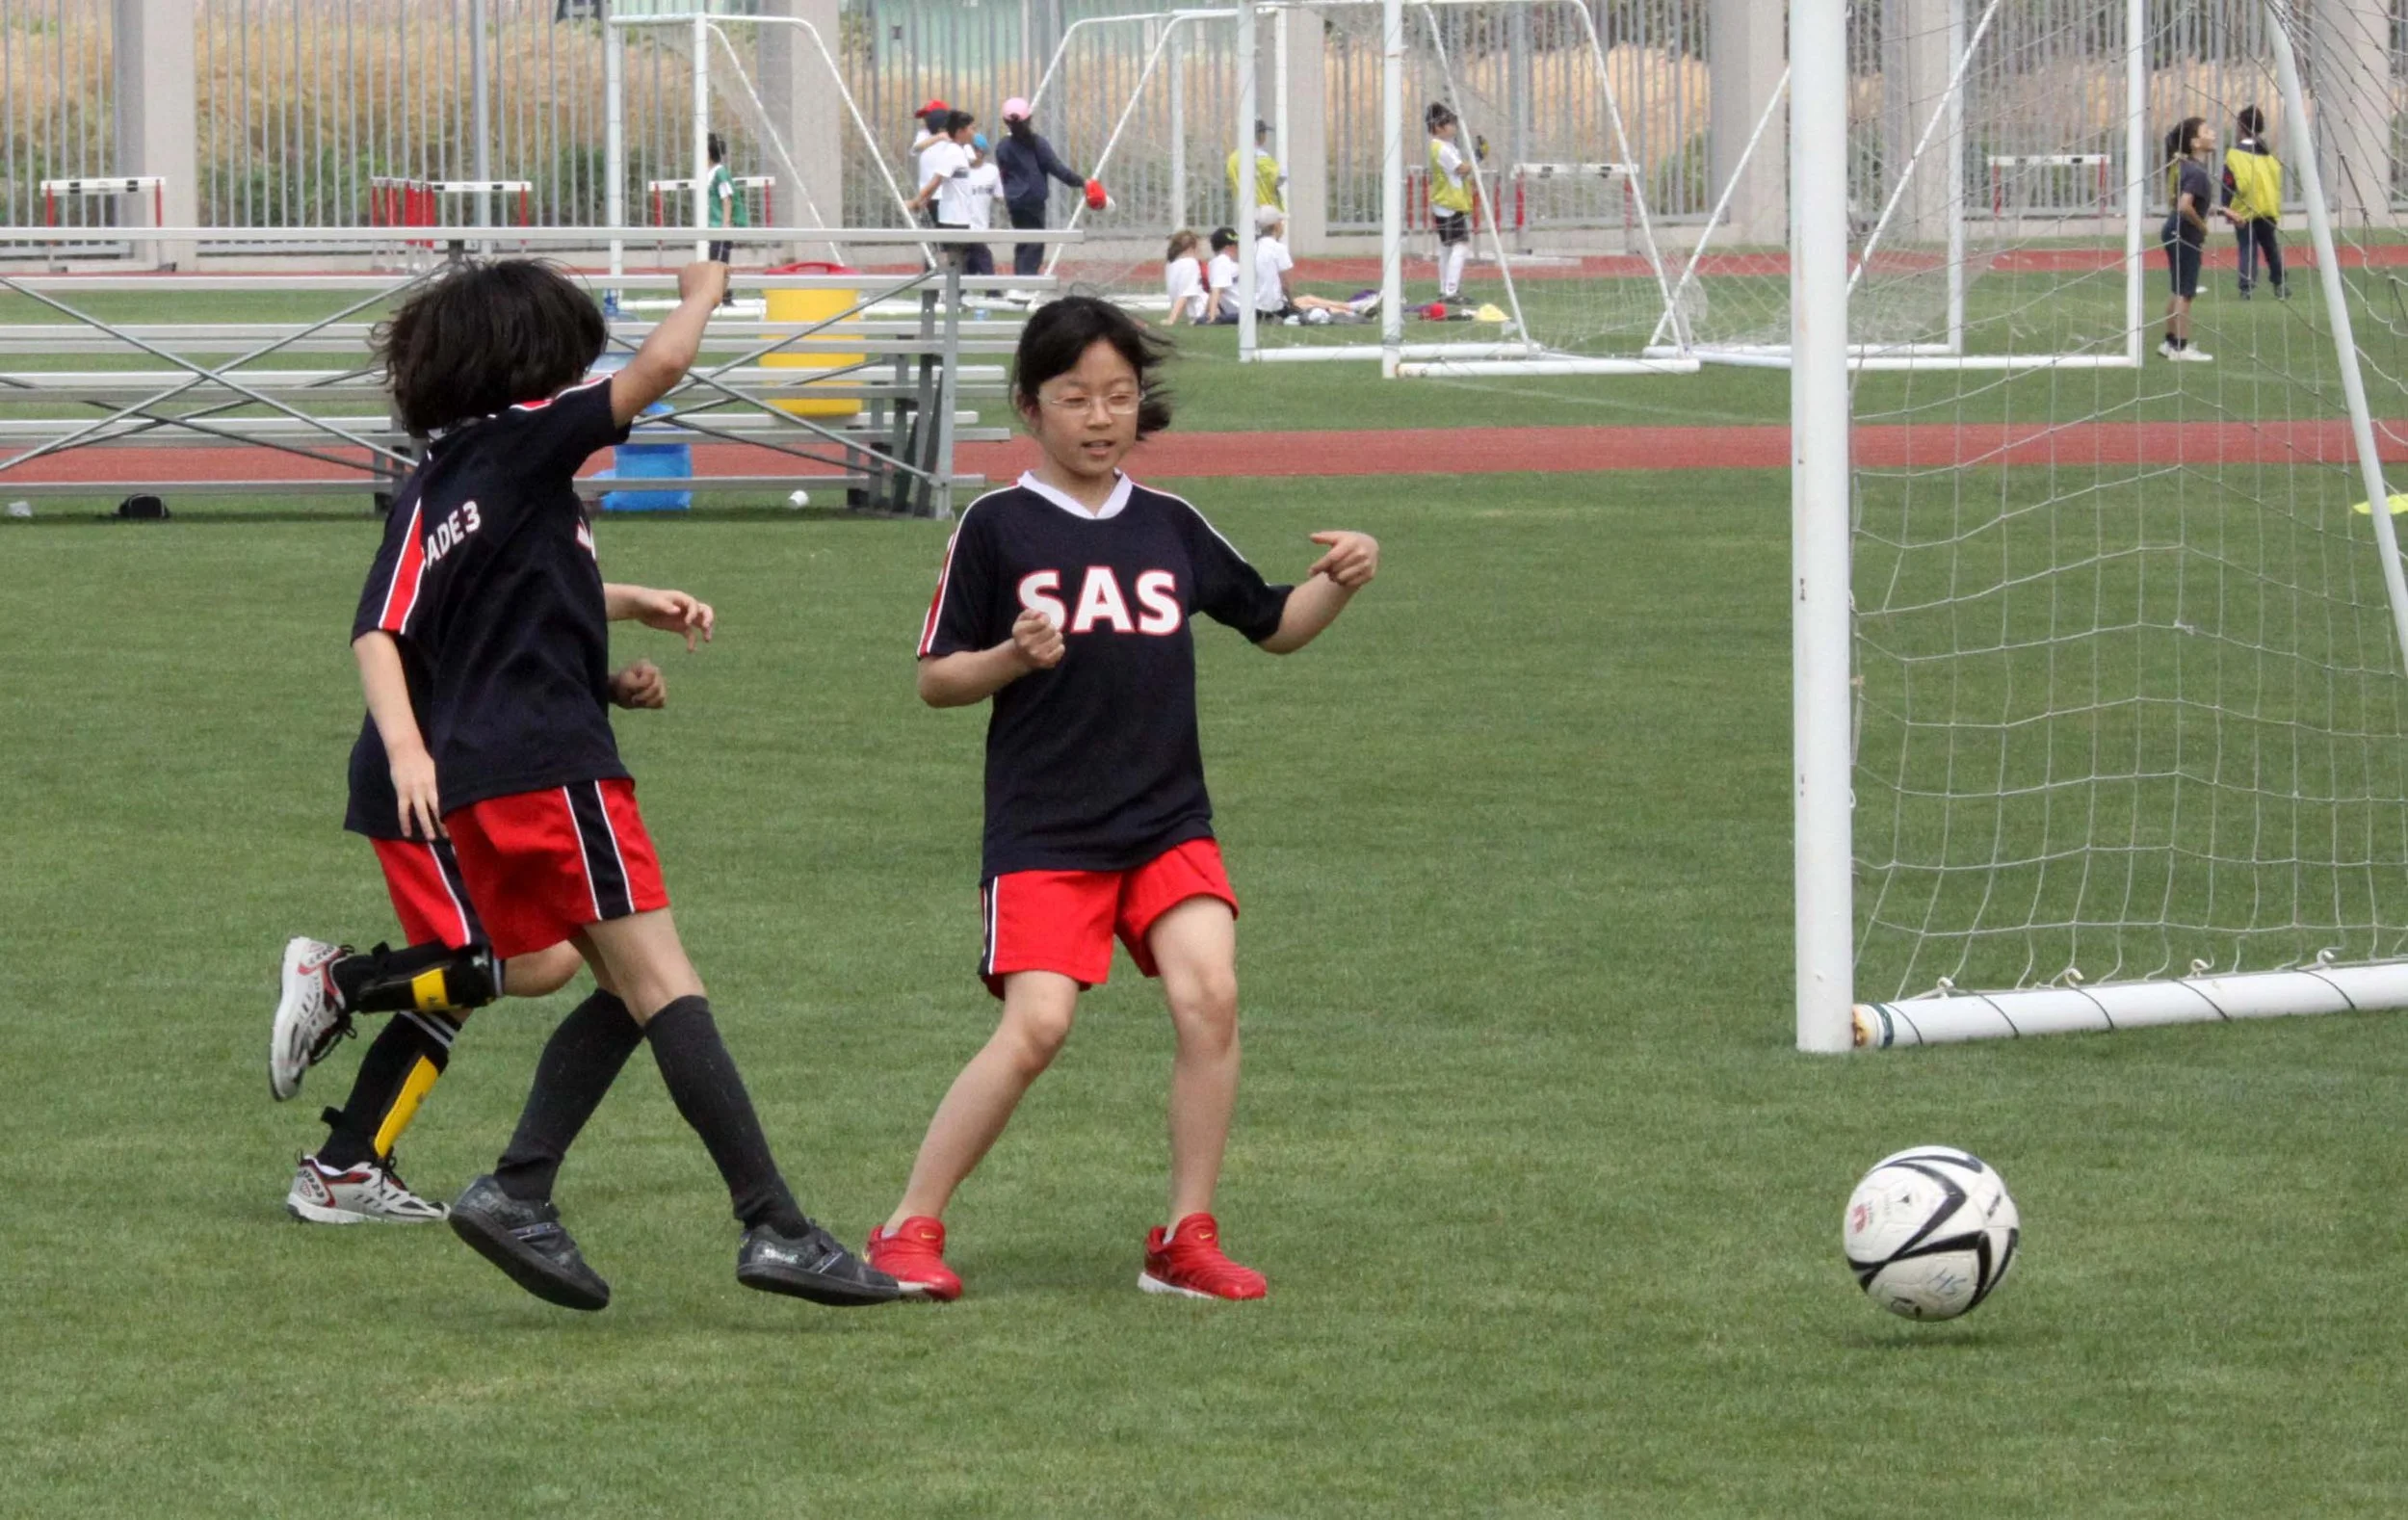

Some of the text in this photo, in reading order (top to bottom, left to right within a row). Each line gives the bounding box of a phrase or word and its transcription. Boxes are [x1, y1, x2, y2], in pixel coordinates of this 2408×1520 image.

[425, 500, 481, 571] ADE 3
[1017, 565, 1182, 636] SAS
